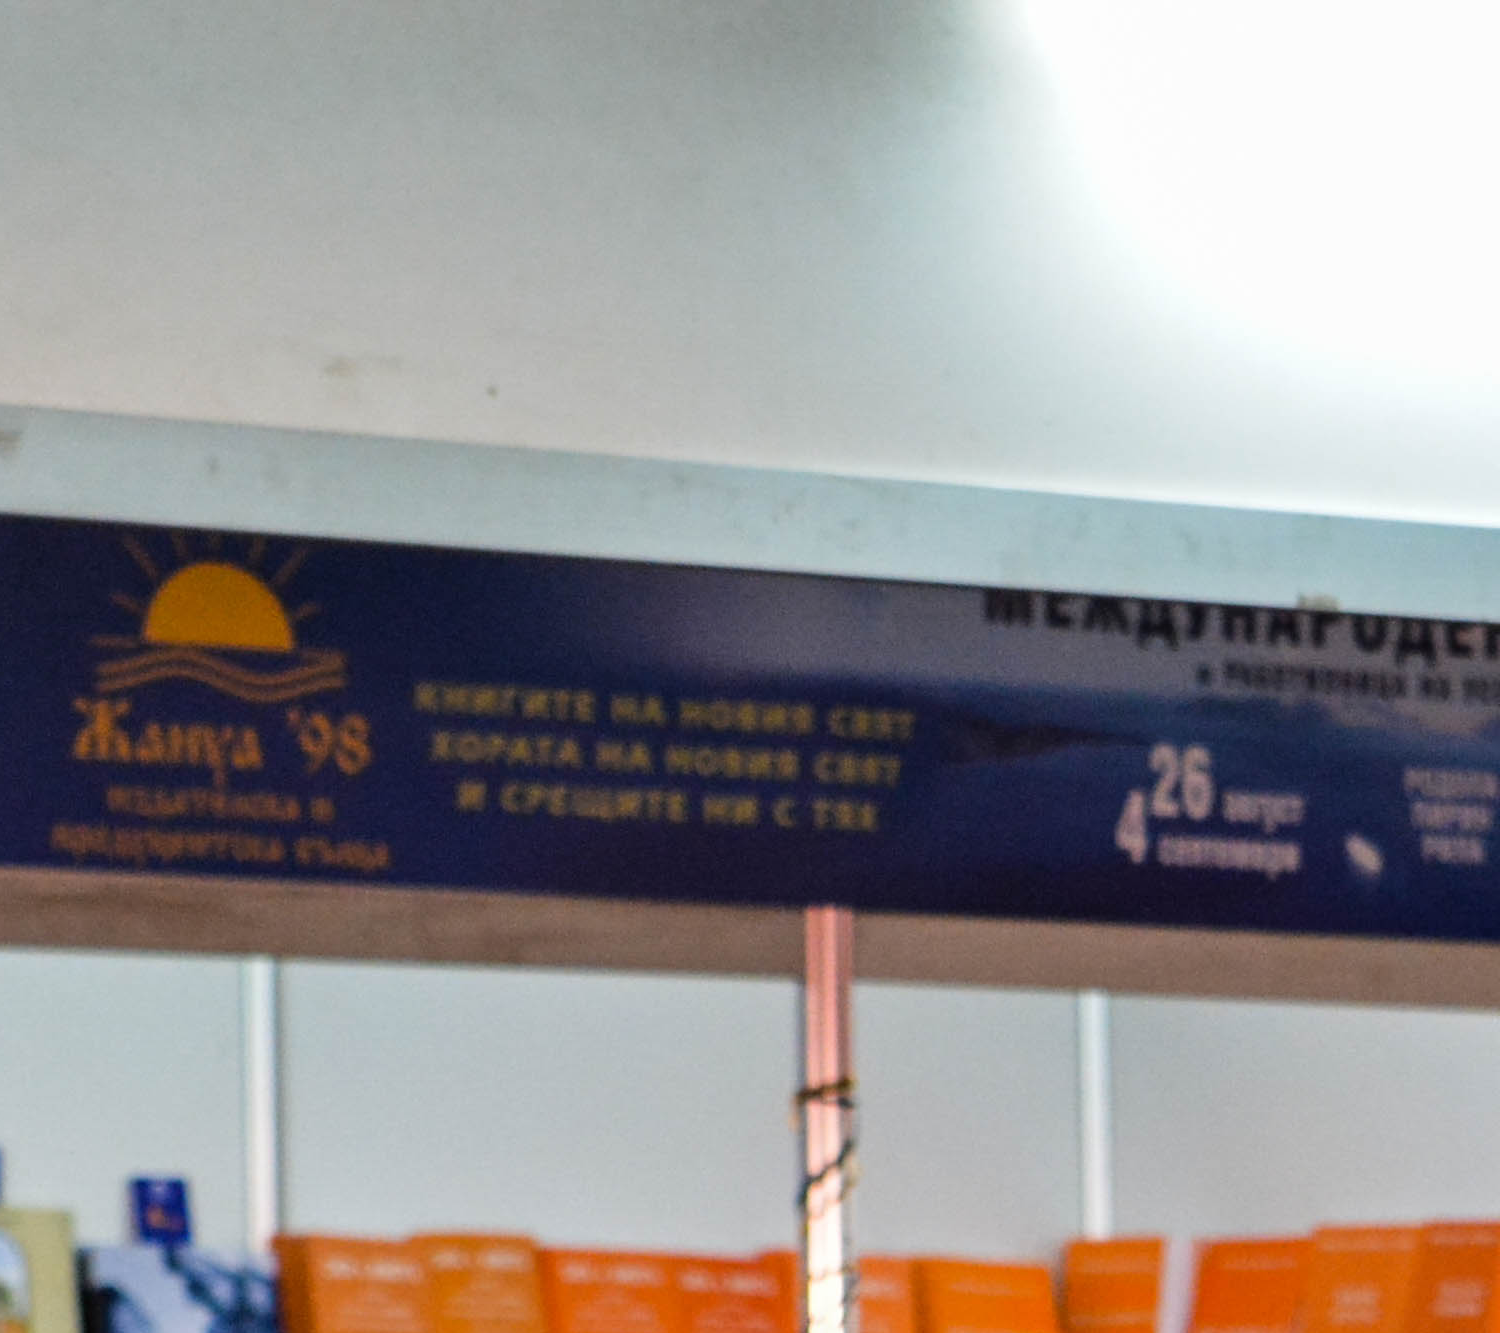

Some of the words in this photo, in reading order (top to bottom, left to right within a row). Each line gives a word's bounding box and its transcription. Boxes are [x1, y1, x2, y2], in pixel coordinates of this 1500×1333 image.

[413, 680, 597, 725] КНИГИТЕ
[609, 694, 667, 726] НА
[431, 730, 582, 768] ХОРАТА
[594, 740, 652, 775] НА
[1148, 742, 1215, 822] 26
[1114, 788, 1148, 867] 4
